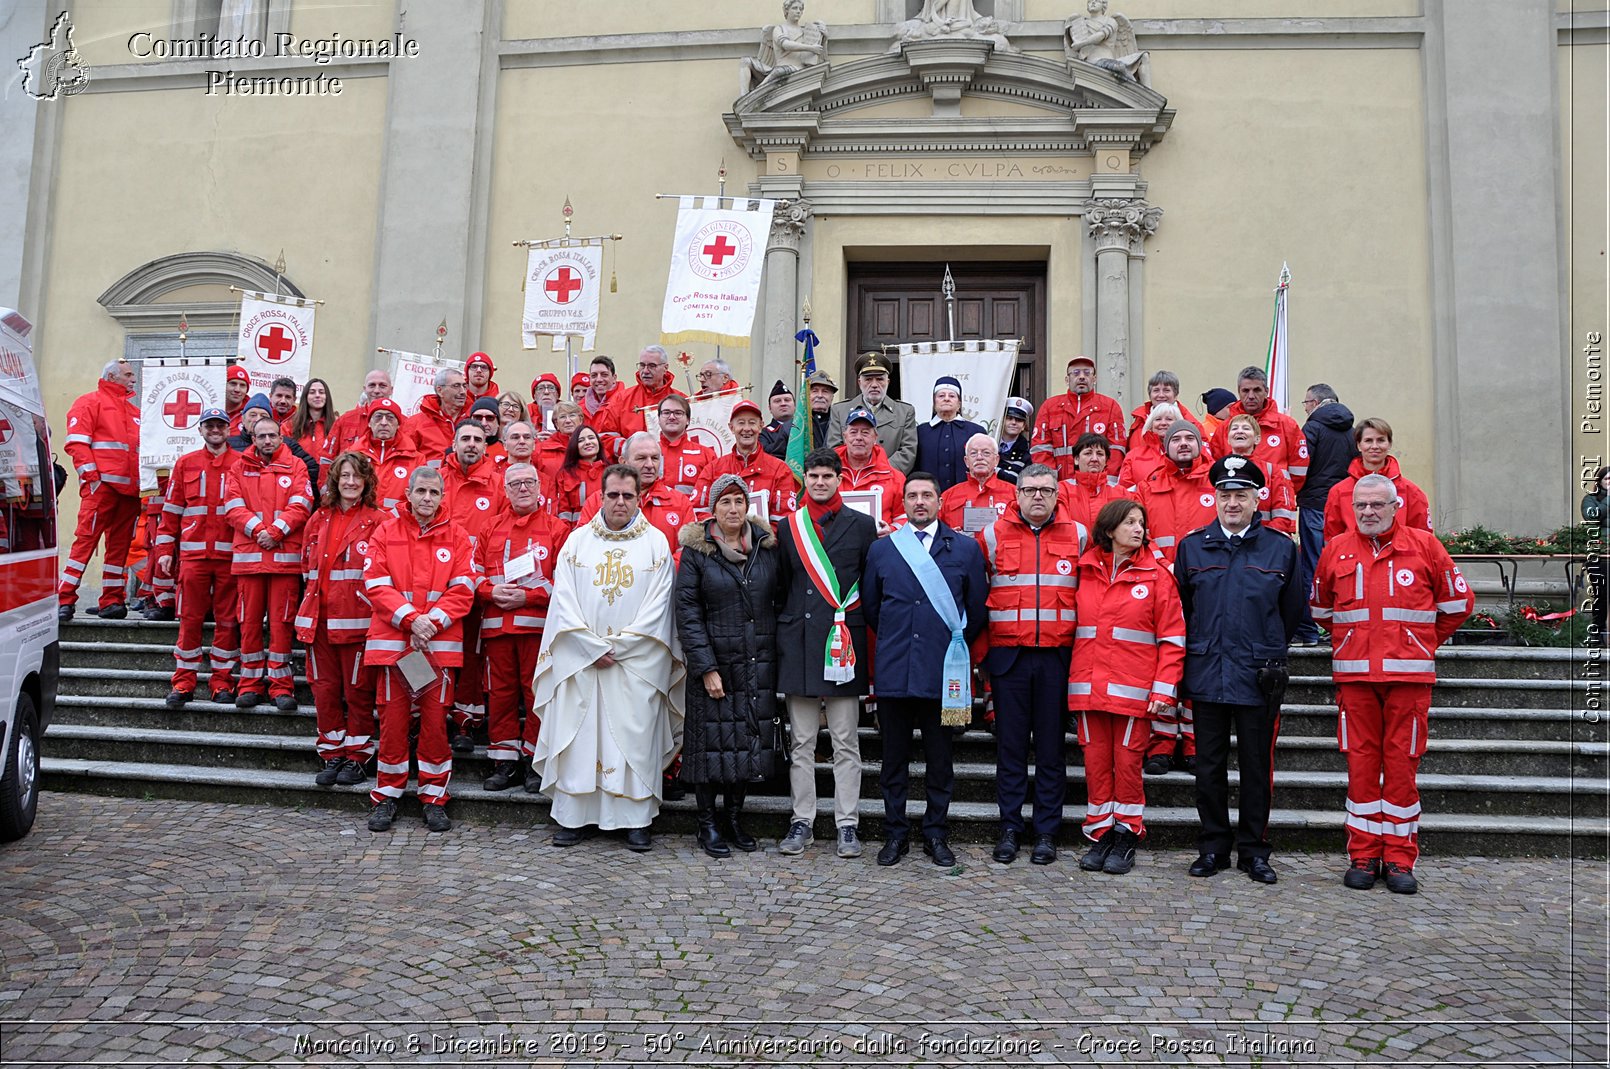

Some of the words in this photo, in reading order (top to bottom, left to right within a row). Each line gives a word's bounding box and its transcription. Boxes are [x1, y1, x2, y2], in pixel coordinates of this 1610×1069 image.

[776, 158, 788, 172] S
[865, 163, 924, 178] FELIX
[948, 162, 1024, 177] CVLPA
[531, 260, 548, 282] CROCE
[548, 252, 570, 264] ROSSA
[573, 252, 596, 280] ITALIANA
[694, 292, 718, 300] Rossa
[721, 293, 748, 301] Italiana
[538, 309, 566, 318] GRUPPO
[243, 315, 260, 338] CROCE
[260, 310, 287, 320] ROSSA
[288, 314, 308, 347] ITALIANA
[405, 363, 437, 376] CROCE
[147, 382, 166, 405] CROCE
[167, 372, 190, 384] ROSSA
[192, 374, 219, 404] ITALIANA
[706, 418, 732, 444] ITALIANA
[167, 437, 196, 445] GRUPPO
